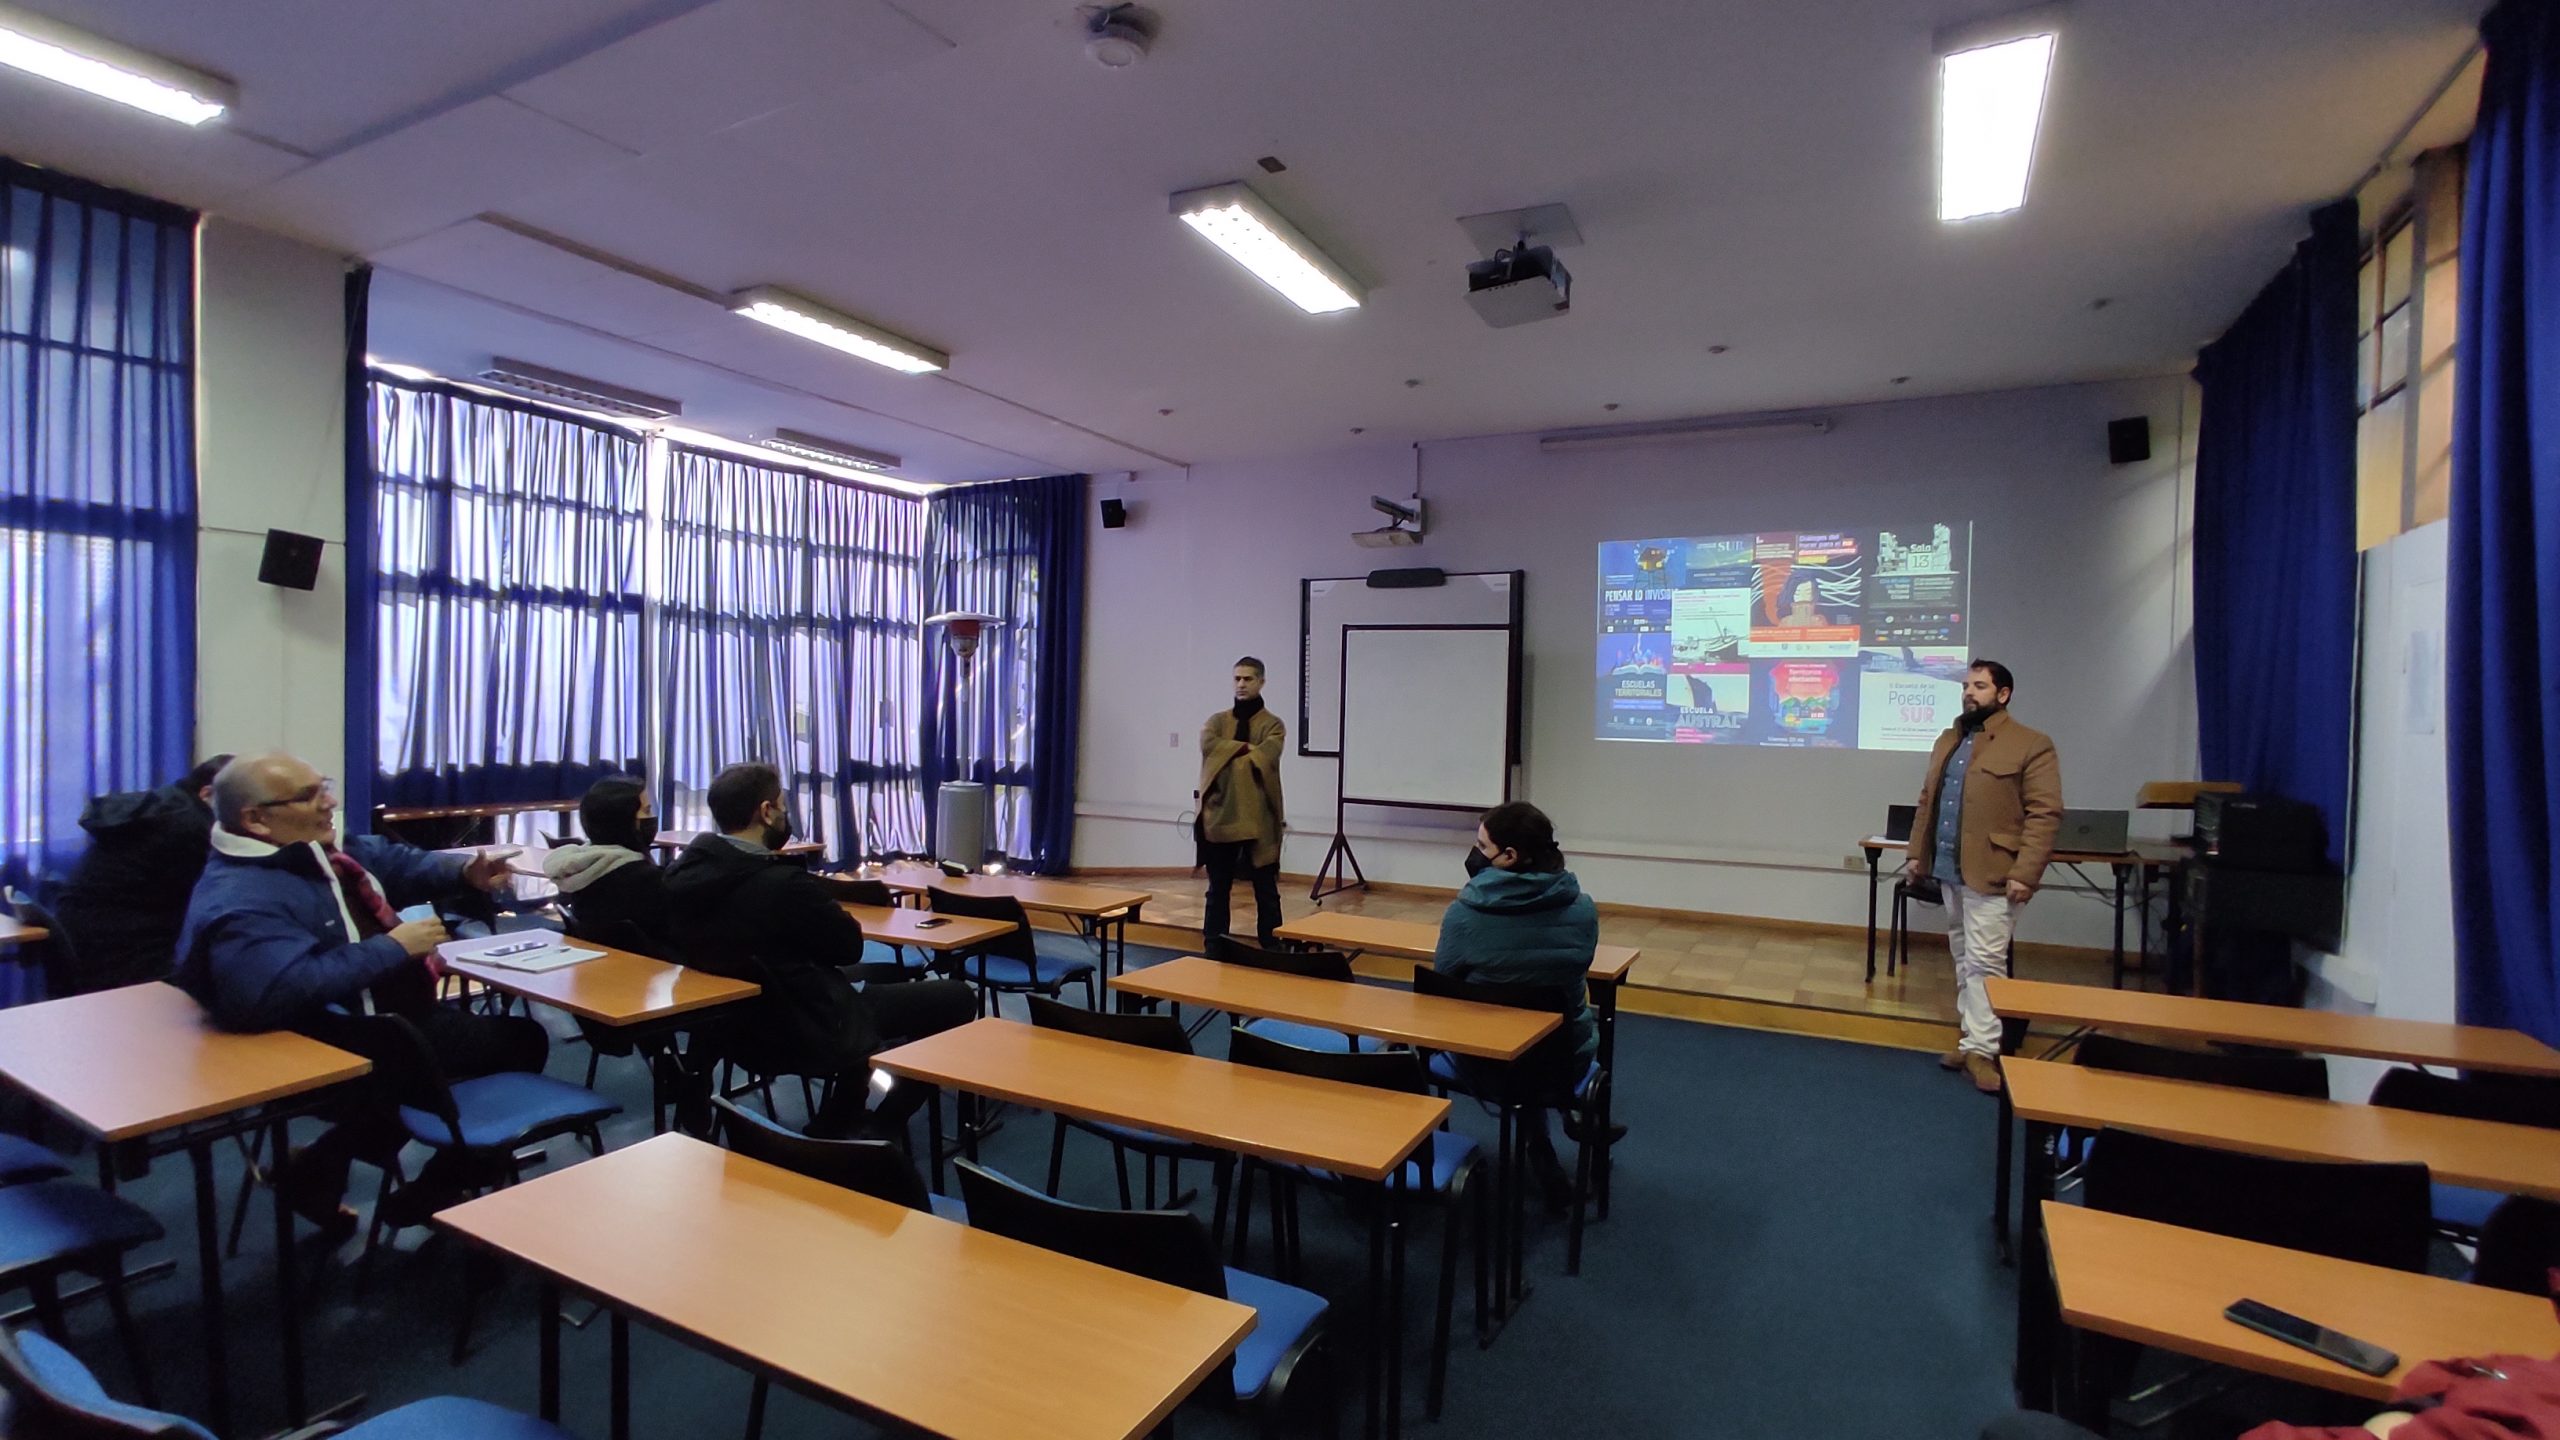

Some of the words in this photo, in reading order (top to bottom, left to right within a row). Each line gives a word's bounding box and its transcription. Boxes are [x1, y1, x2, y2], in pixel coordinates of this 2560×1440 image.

[1910, 544, 1932, 553] Sala
[1912, 554, 1930, 569] 13
[1605, 589, 1633, 602] PENSAR
[1634, 589, 1643, 601] LO
[1622, 680, 1656, 689] ESCUELAS
[1615, 688, 1662, 696] TERRITORIALES
[1680, 706, 1714, 714] ESCUELA
[1900, 706, 1935, 724] SUR
[1676, 714, 1741, 729] AUSTRAL
